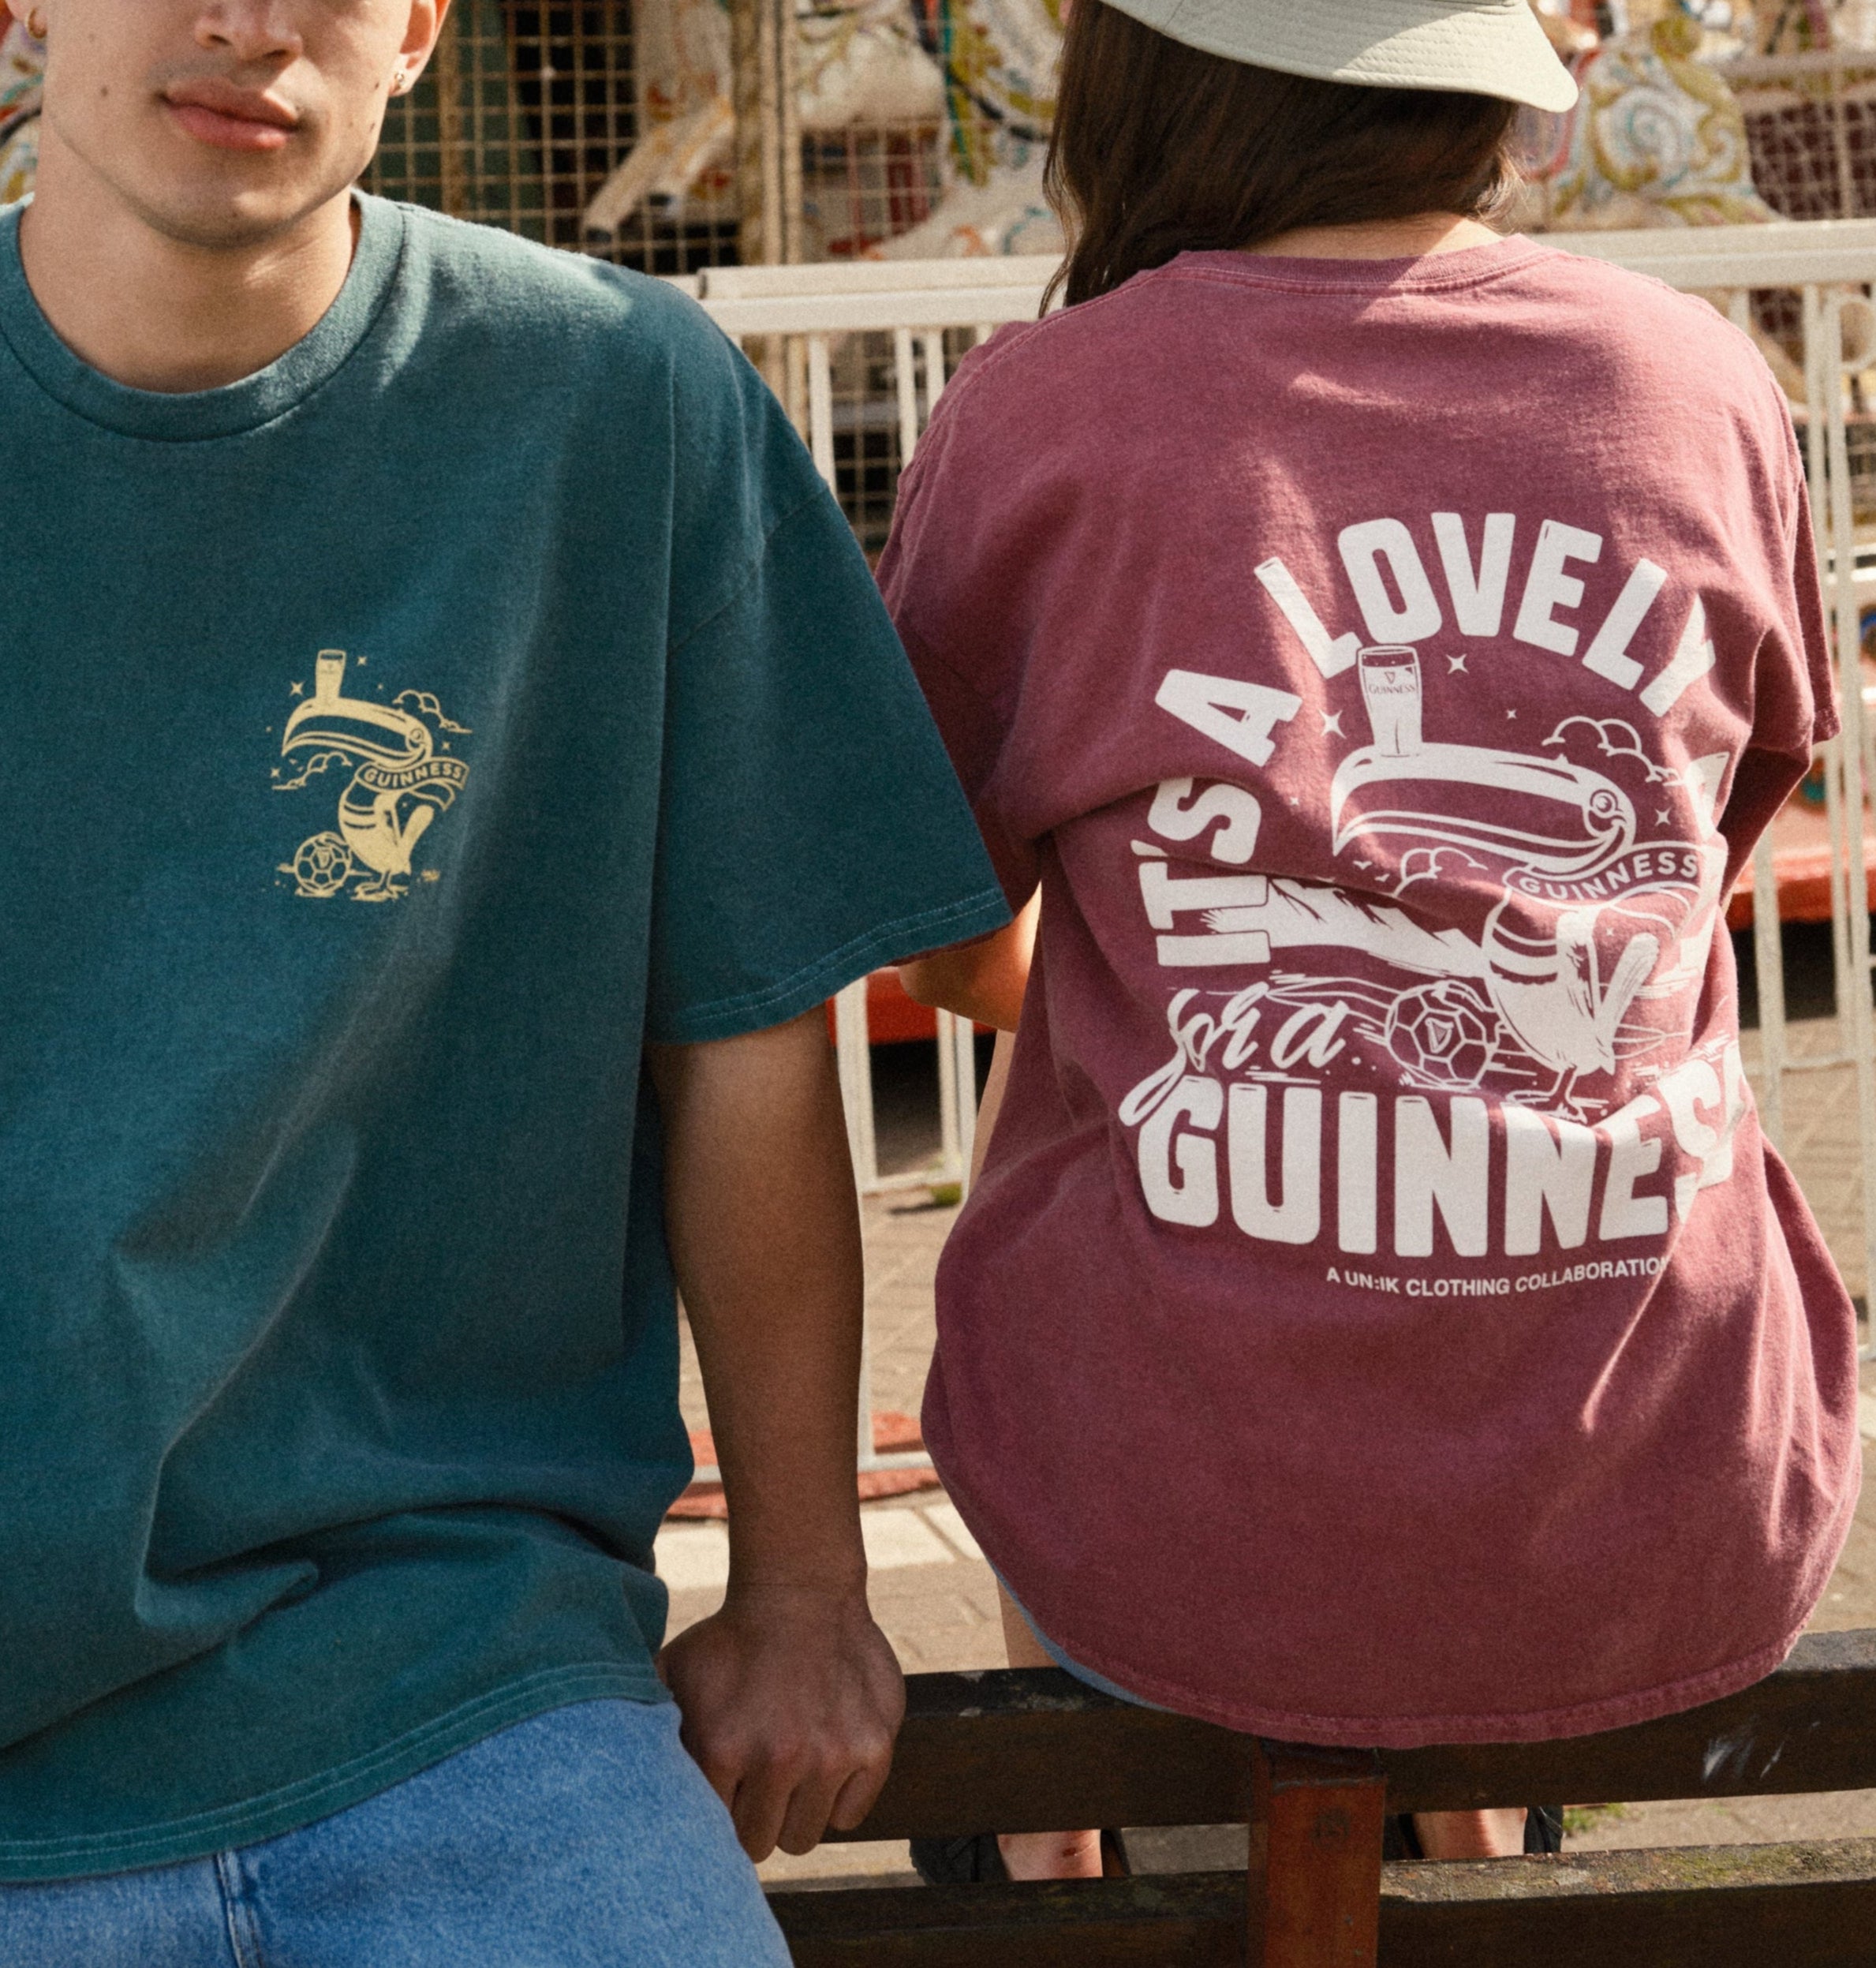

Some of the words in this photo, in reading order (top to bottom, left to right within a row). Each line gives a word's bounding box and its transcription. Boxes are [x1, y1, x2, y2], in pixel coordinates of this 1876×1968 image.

[1154, 668, 1302, 767] A
[364, 762, 462, 787] GUINNESS
[1518, 851, 1698, 900] GUINNESS
[1138, 1040, 1747, 1257] GUINNES
[1326, 1266, 1340, 1283] A
[1344, 1270, 1400, 1294] UN:IK
[1405, 1278, 1511, 1296] CLOTHING
